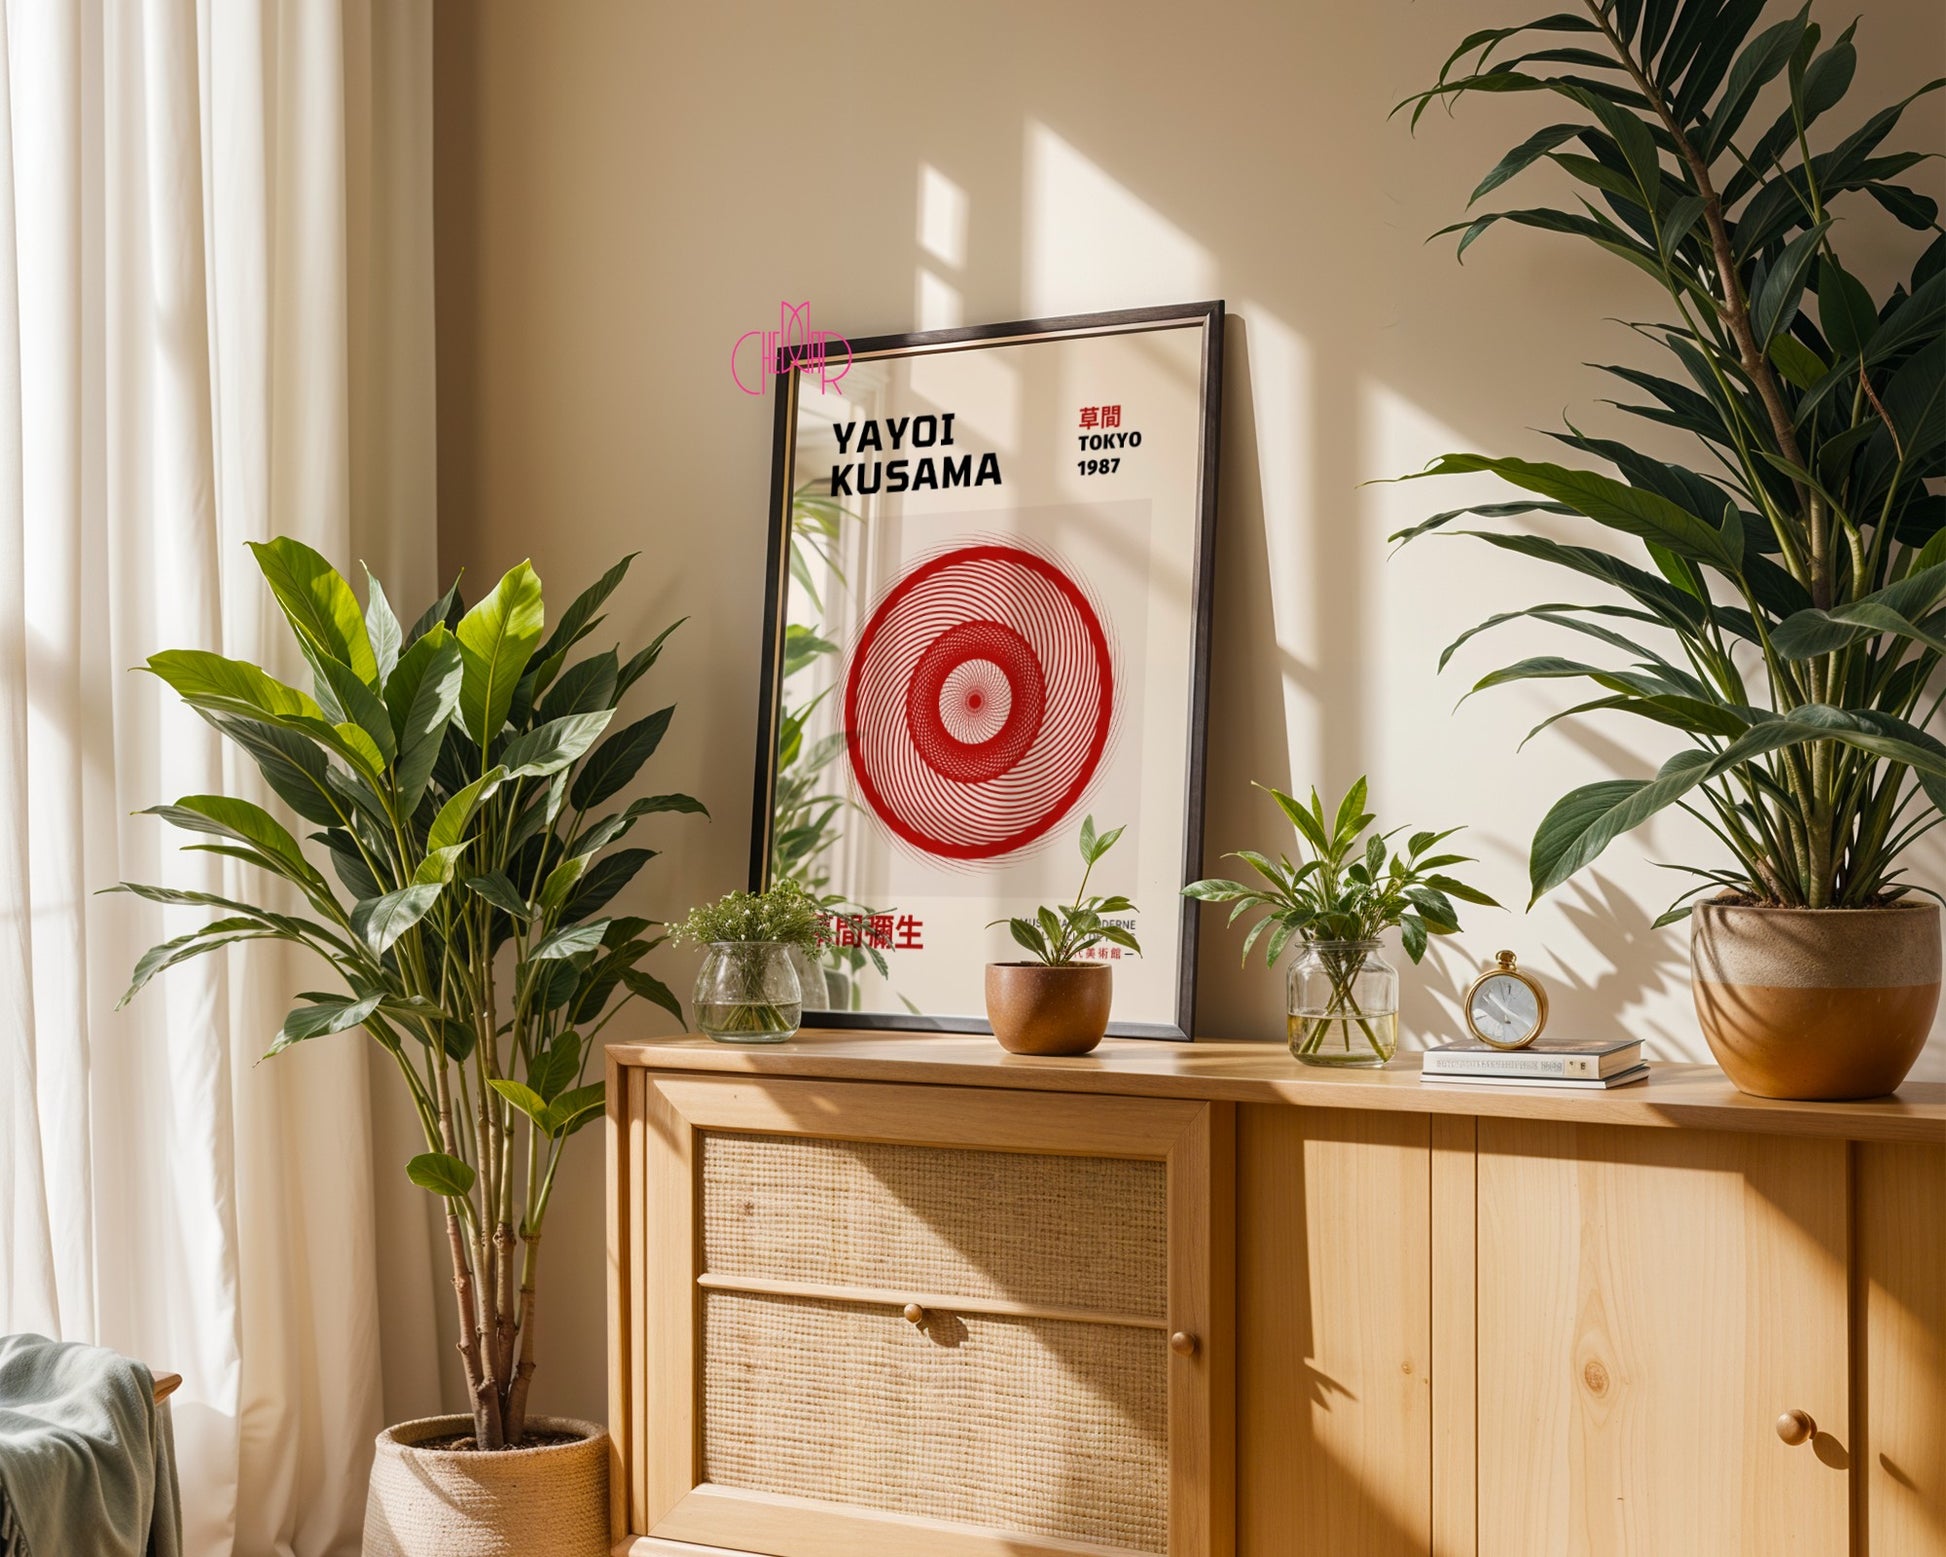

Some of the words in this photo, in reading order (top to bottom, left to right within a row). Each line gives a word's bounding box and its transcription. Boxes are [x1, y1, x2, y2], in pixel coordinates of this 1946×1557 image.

[1079, 405, 1122, 430] 草間
[832, 413, 956, 454] YAYOI
[1078, 431, 1142, 451] TOKYO
[830, 452, 1002, 497] KUSAMA
[1077, 458, 1121, 476] 1987
[815, 913, 924, 950] 間彌生
